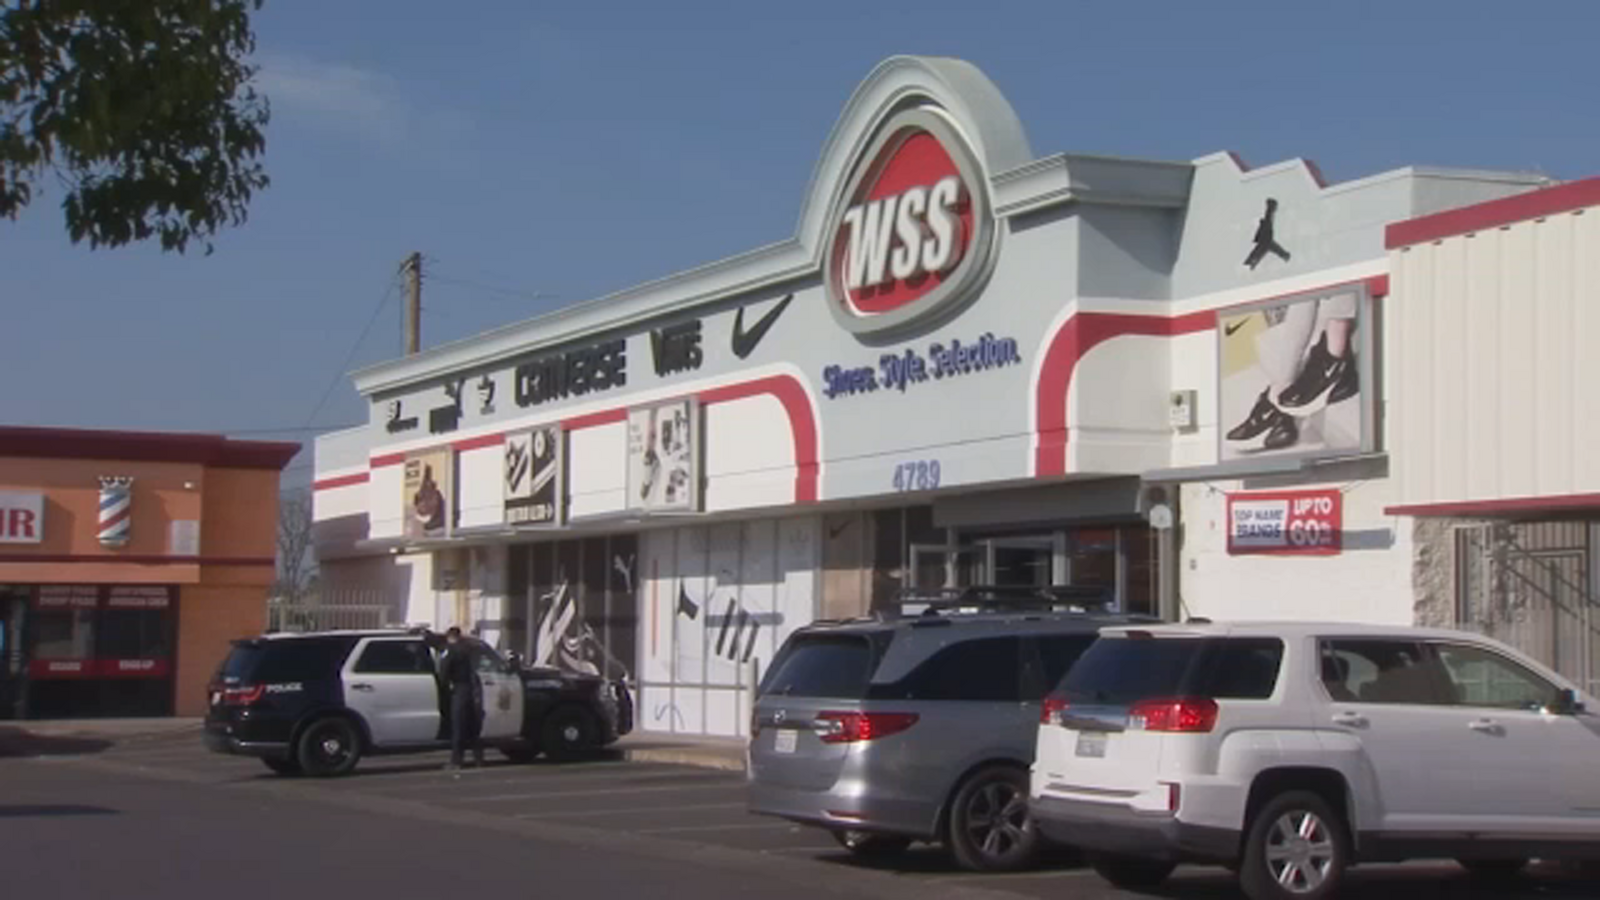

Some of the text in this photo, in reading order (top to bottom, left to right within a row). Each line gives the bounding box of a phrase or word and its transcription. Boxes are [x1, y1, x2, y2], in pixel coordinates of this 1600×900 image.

[844, 175, 960, 291] WSS
[892, 459, 941, 493] 4789
[266, 681, 303, 694] POLICE
